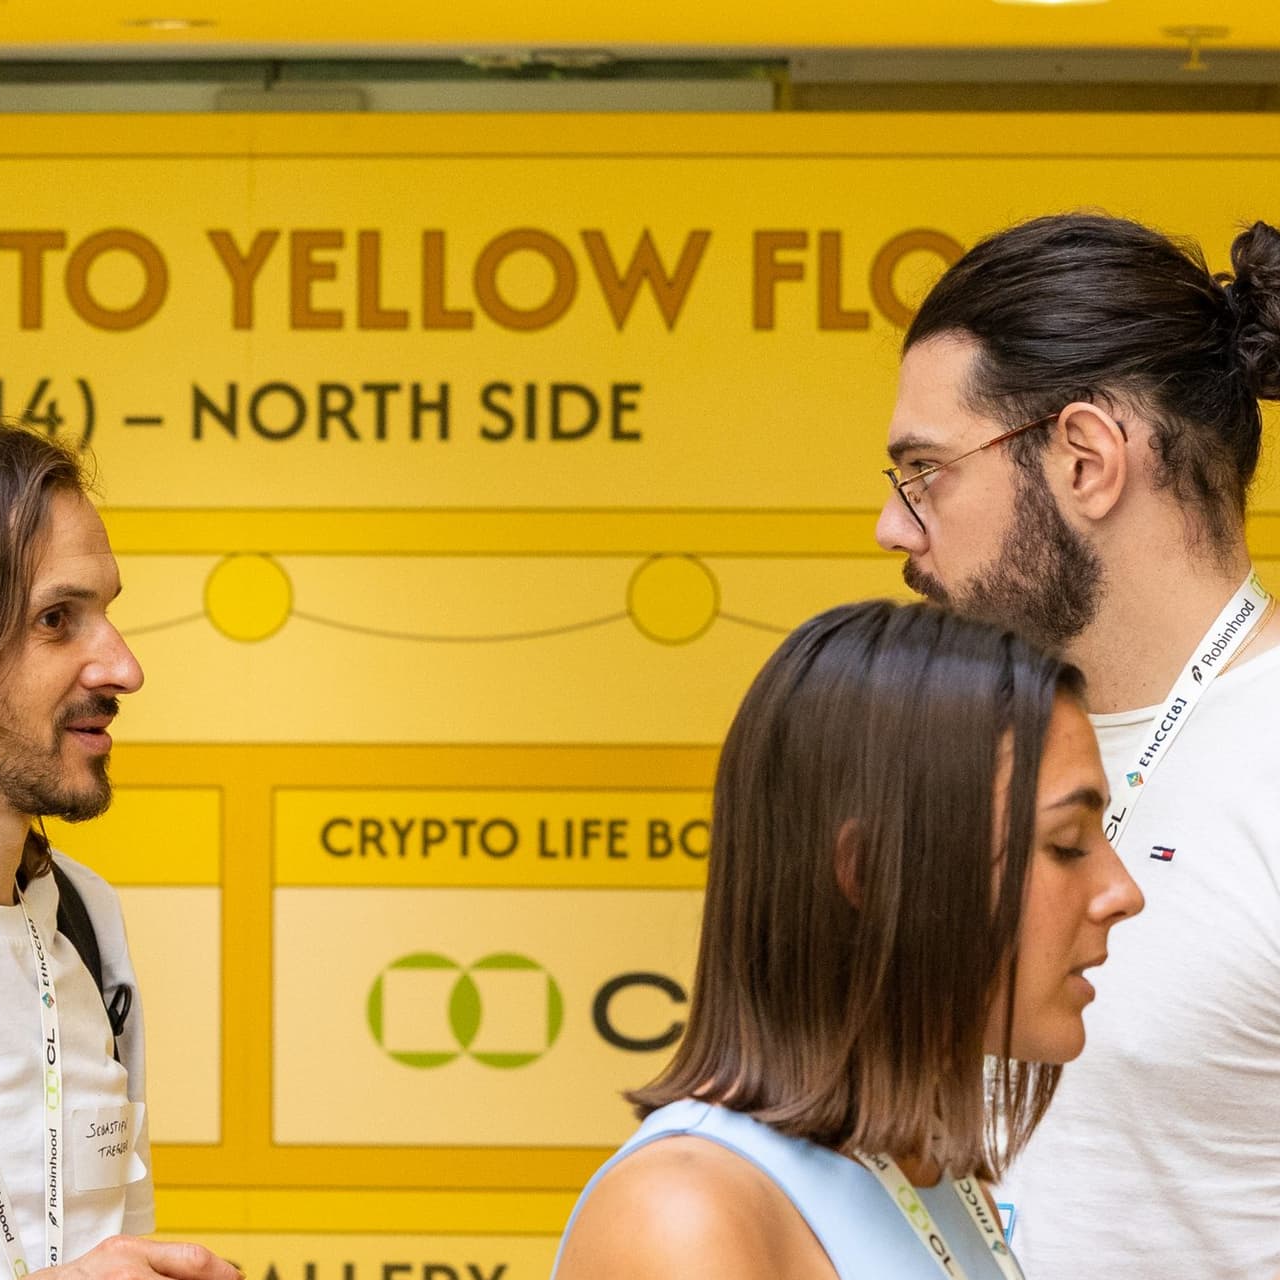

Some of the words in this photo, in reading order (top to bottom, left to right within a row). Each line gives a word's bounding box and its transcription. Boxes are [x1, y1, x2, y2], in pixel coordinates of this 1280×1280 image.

[206, 228, 713, 333] YELLOW
[190, 381, 451, 443] NORTH
[479, 381, 642, 443] SIDE
[1104, 807, 1127, 842] CL
[1138, 697, 1187, 768] EthCC[8]
[1201, 598, 1256, 667] Robinhood
[320, 818, 519, 859] CRYPTO
[538, 819, 628, 859] LIFE
[46, 1028, 56, 1065] CL
[48, 1128, 58, 1208] Robinhood
[929, 1233, 954, 1276] CL
